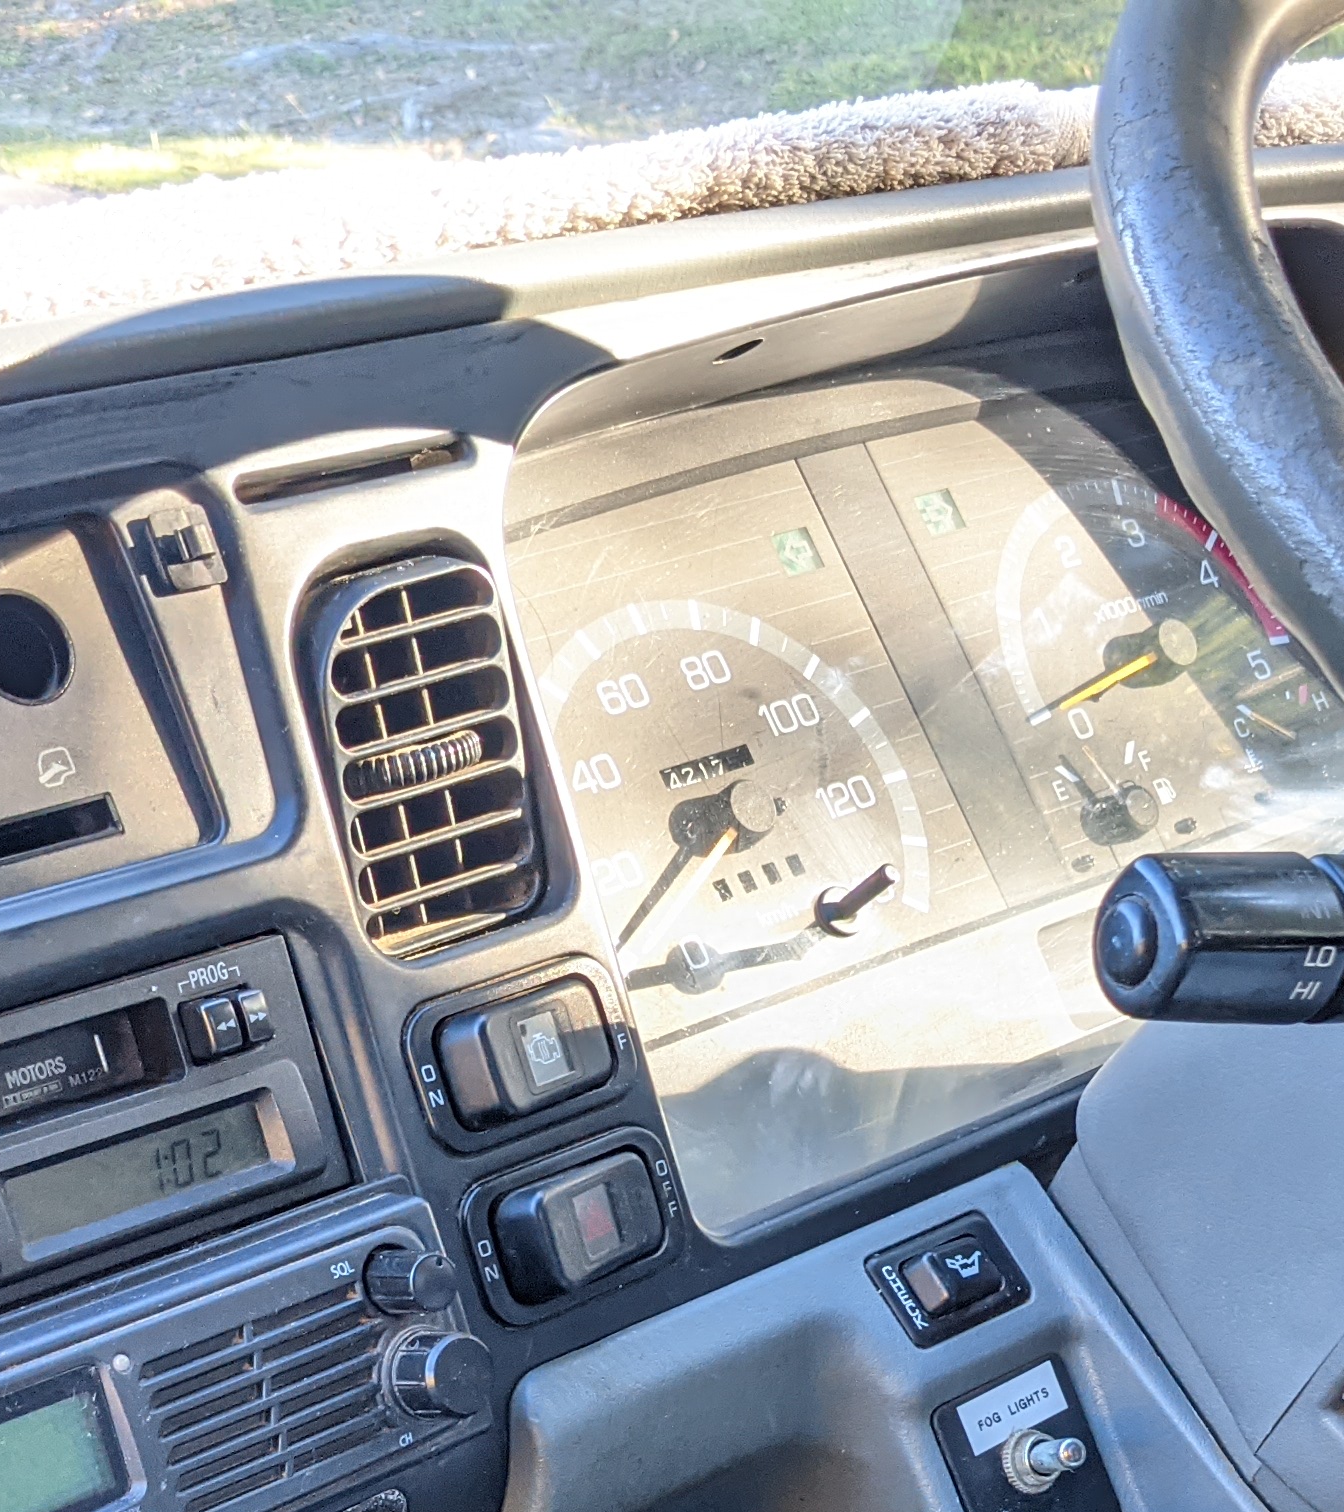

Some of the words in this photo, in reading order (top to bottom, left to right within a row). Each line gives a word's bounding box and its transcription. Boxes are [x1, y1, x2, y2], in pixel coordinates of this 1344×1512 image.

[1121, 519, 1145, 549] 3
[1055, 535, 1083, 569] 2
[1199, 560, 1220, 589] 4
[679, 650, 732, 692] 80
[1246, 649, 1271, 681] 5
[596, 673, 651, 716] 60
[1311, 692, 1330, 713] H
[758, 693, 821, 737] 100
[1067, 707, 1095, 740] 0
[1233, 718, 1250, 739] C
[571, 752, 622, 795] 40
[1137, 751, 1152, 772] F
[815, 774, 876, 820] 120
[1052, 779, 1070, 802] E
[591, 851, 645, 893] 20
[679, 935, 710, 969] 0
[1303, 945, 1338, 968] LO
[187, 962, 229, 990] PROG
[1288, 981, 1323, 1000] HI
[4, 1056, 67, 1090] MOTORS
[420, 1064, 446, 1108] ON
[655, 1159, 678, 1219] OFF
[330, 1258, 355, 1280] SQL
[477, 1239, 501, 1283] ON
[881, 1265, 930, 1330] CHECK
[976, 1410, 1003, 1432] FOG
[1007, 1386, 1050, 1417] LIGHTS
[398, 1432, 414, 1448] CH
